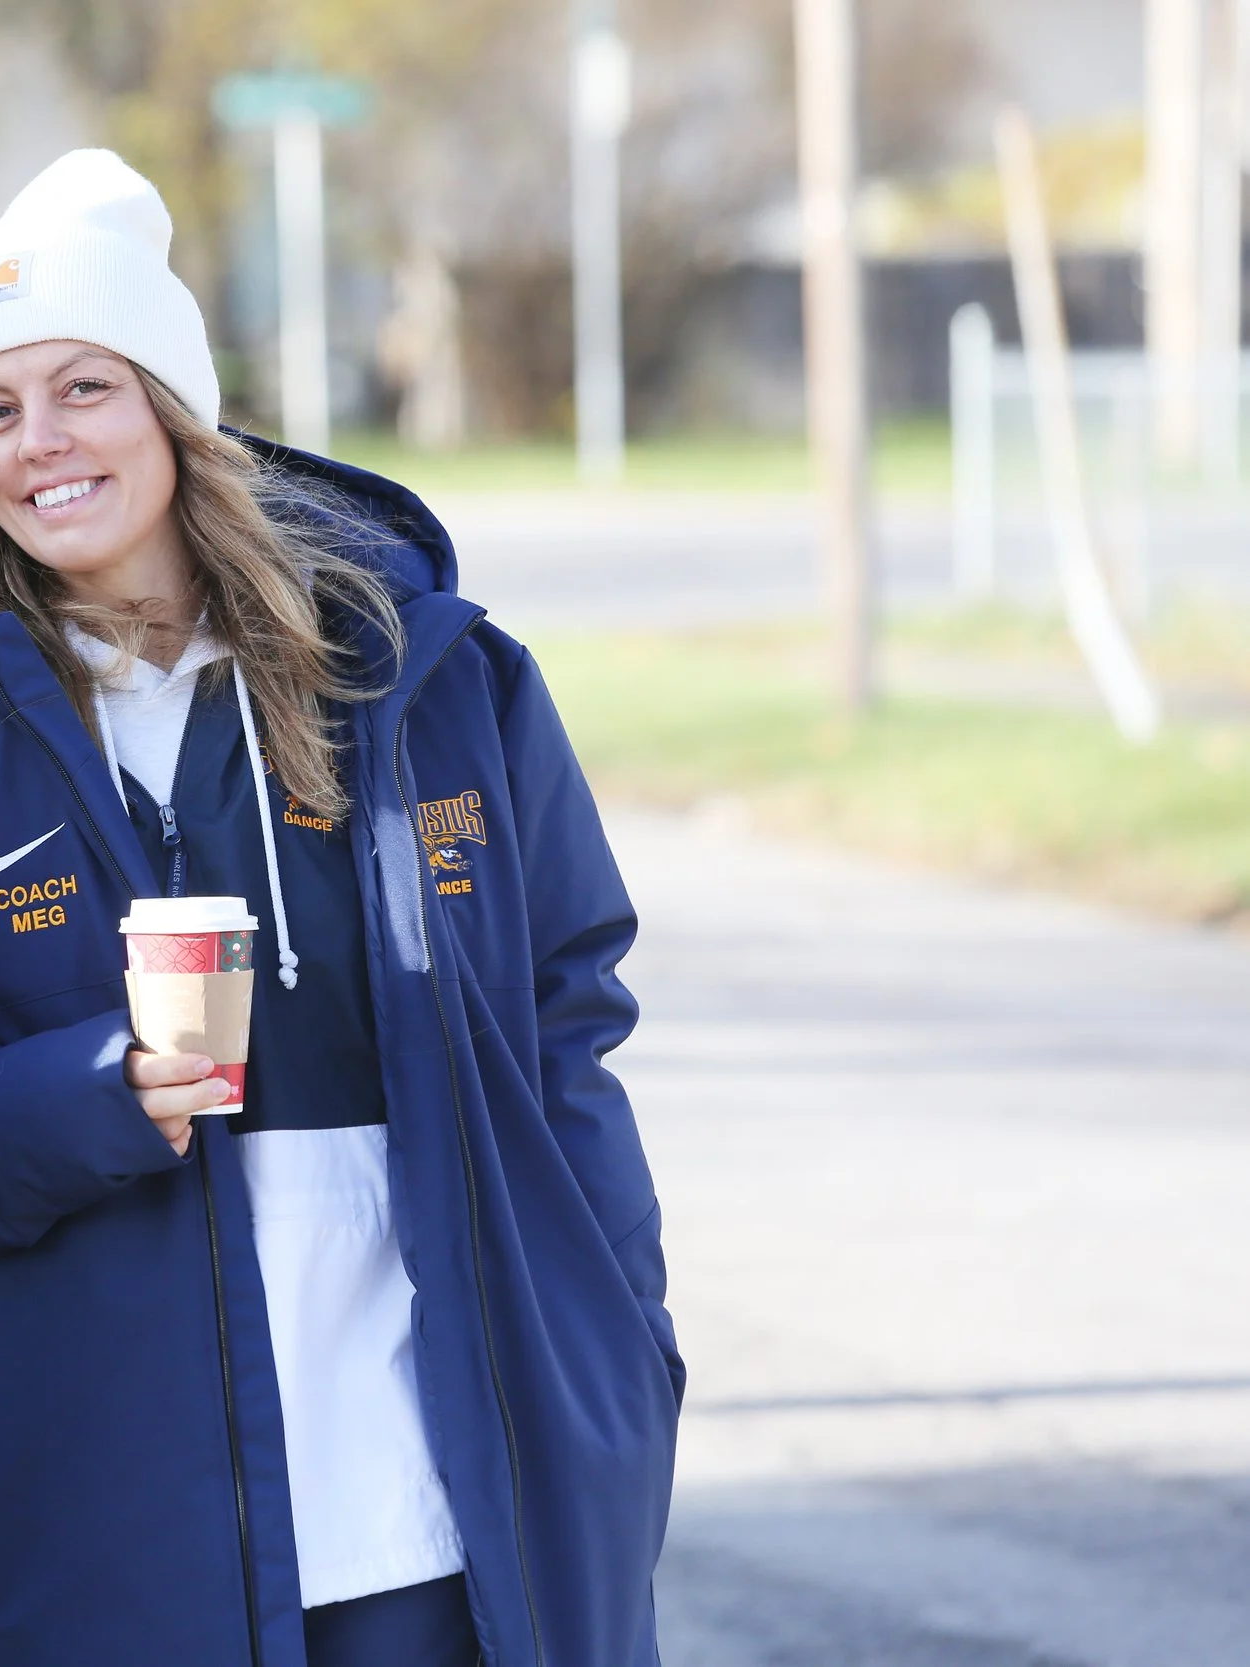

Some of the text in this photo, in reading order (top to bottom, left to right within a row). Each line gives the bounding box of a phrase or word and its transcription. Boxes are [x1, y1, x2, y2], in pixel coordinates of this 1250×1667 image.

[283, 811, 334, 832] DANCE
[173, 849, 182, 883] HARLES
[11, 905, 66, 934] MEG
